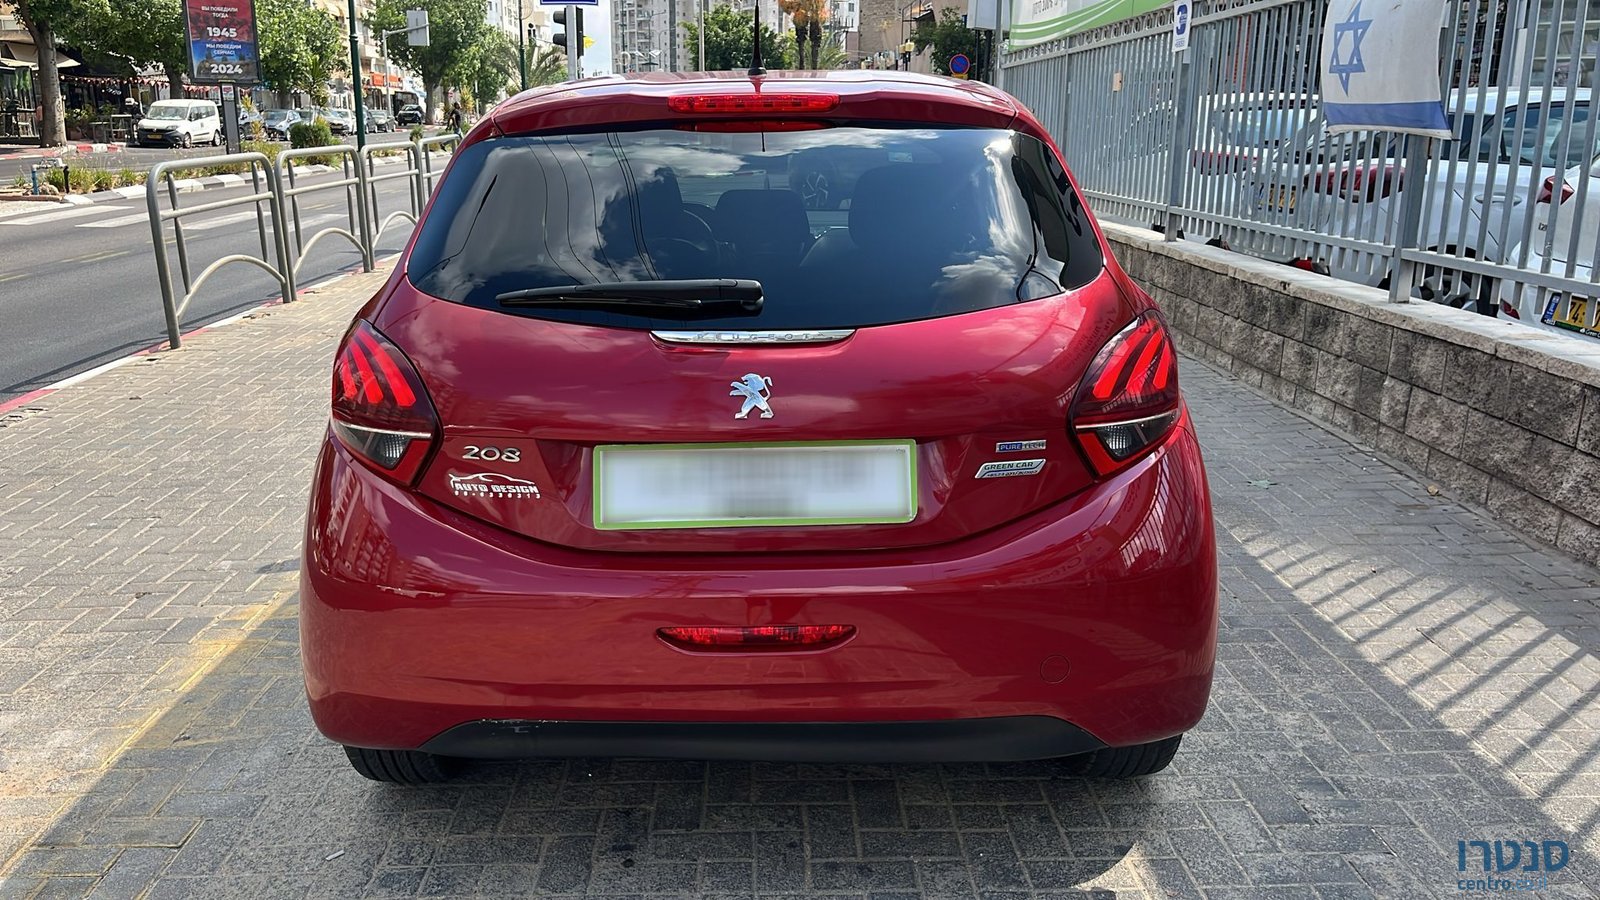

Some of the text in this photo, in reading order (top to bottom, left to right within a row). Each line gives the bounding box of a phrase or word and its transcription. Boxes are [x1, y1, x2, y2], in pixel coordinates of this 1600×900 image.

[206, 27, 237, 37] 1945
[211, 63, 243, 74] 2024
[462, 445, 521, 463] 208
[454, 483, 539, 493] AUTO DESIGN
